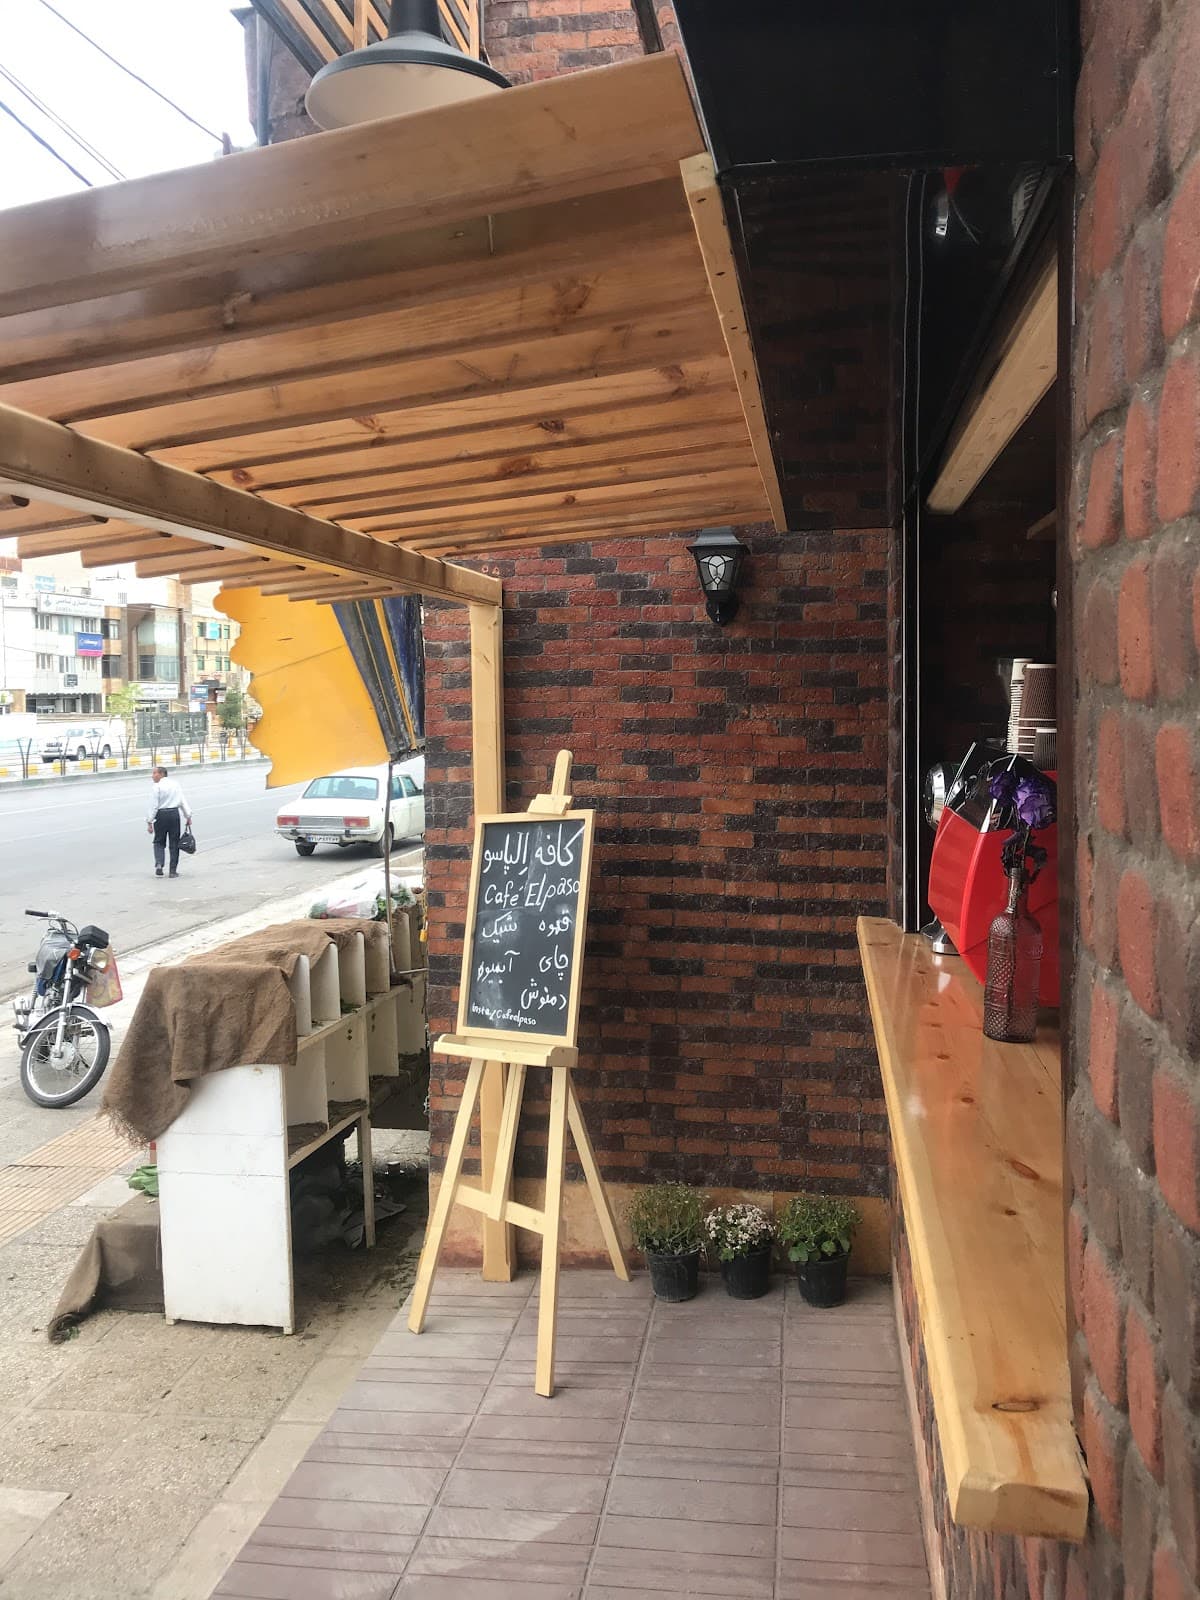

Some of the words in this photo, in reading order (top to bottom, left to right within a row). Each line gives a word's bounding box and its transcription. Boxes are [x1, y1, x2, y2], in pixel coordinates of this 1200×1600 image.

[534, 823, 585, 866] کافه
[481, 911, 518, 943] شیک
[538, 909, 573, 937] قهوه
[477, 950, 521, 983] آبمیوه
[538, 944, 569, 981] چای
[520, 978, 567, 1010] دمنوش
